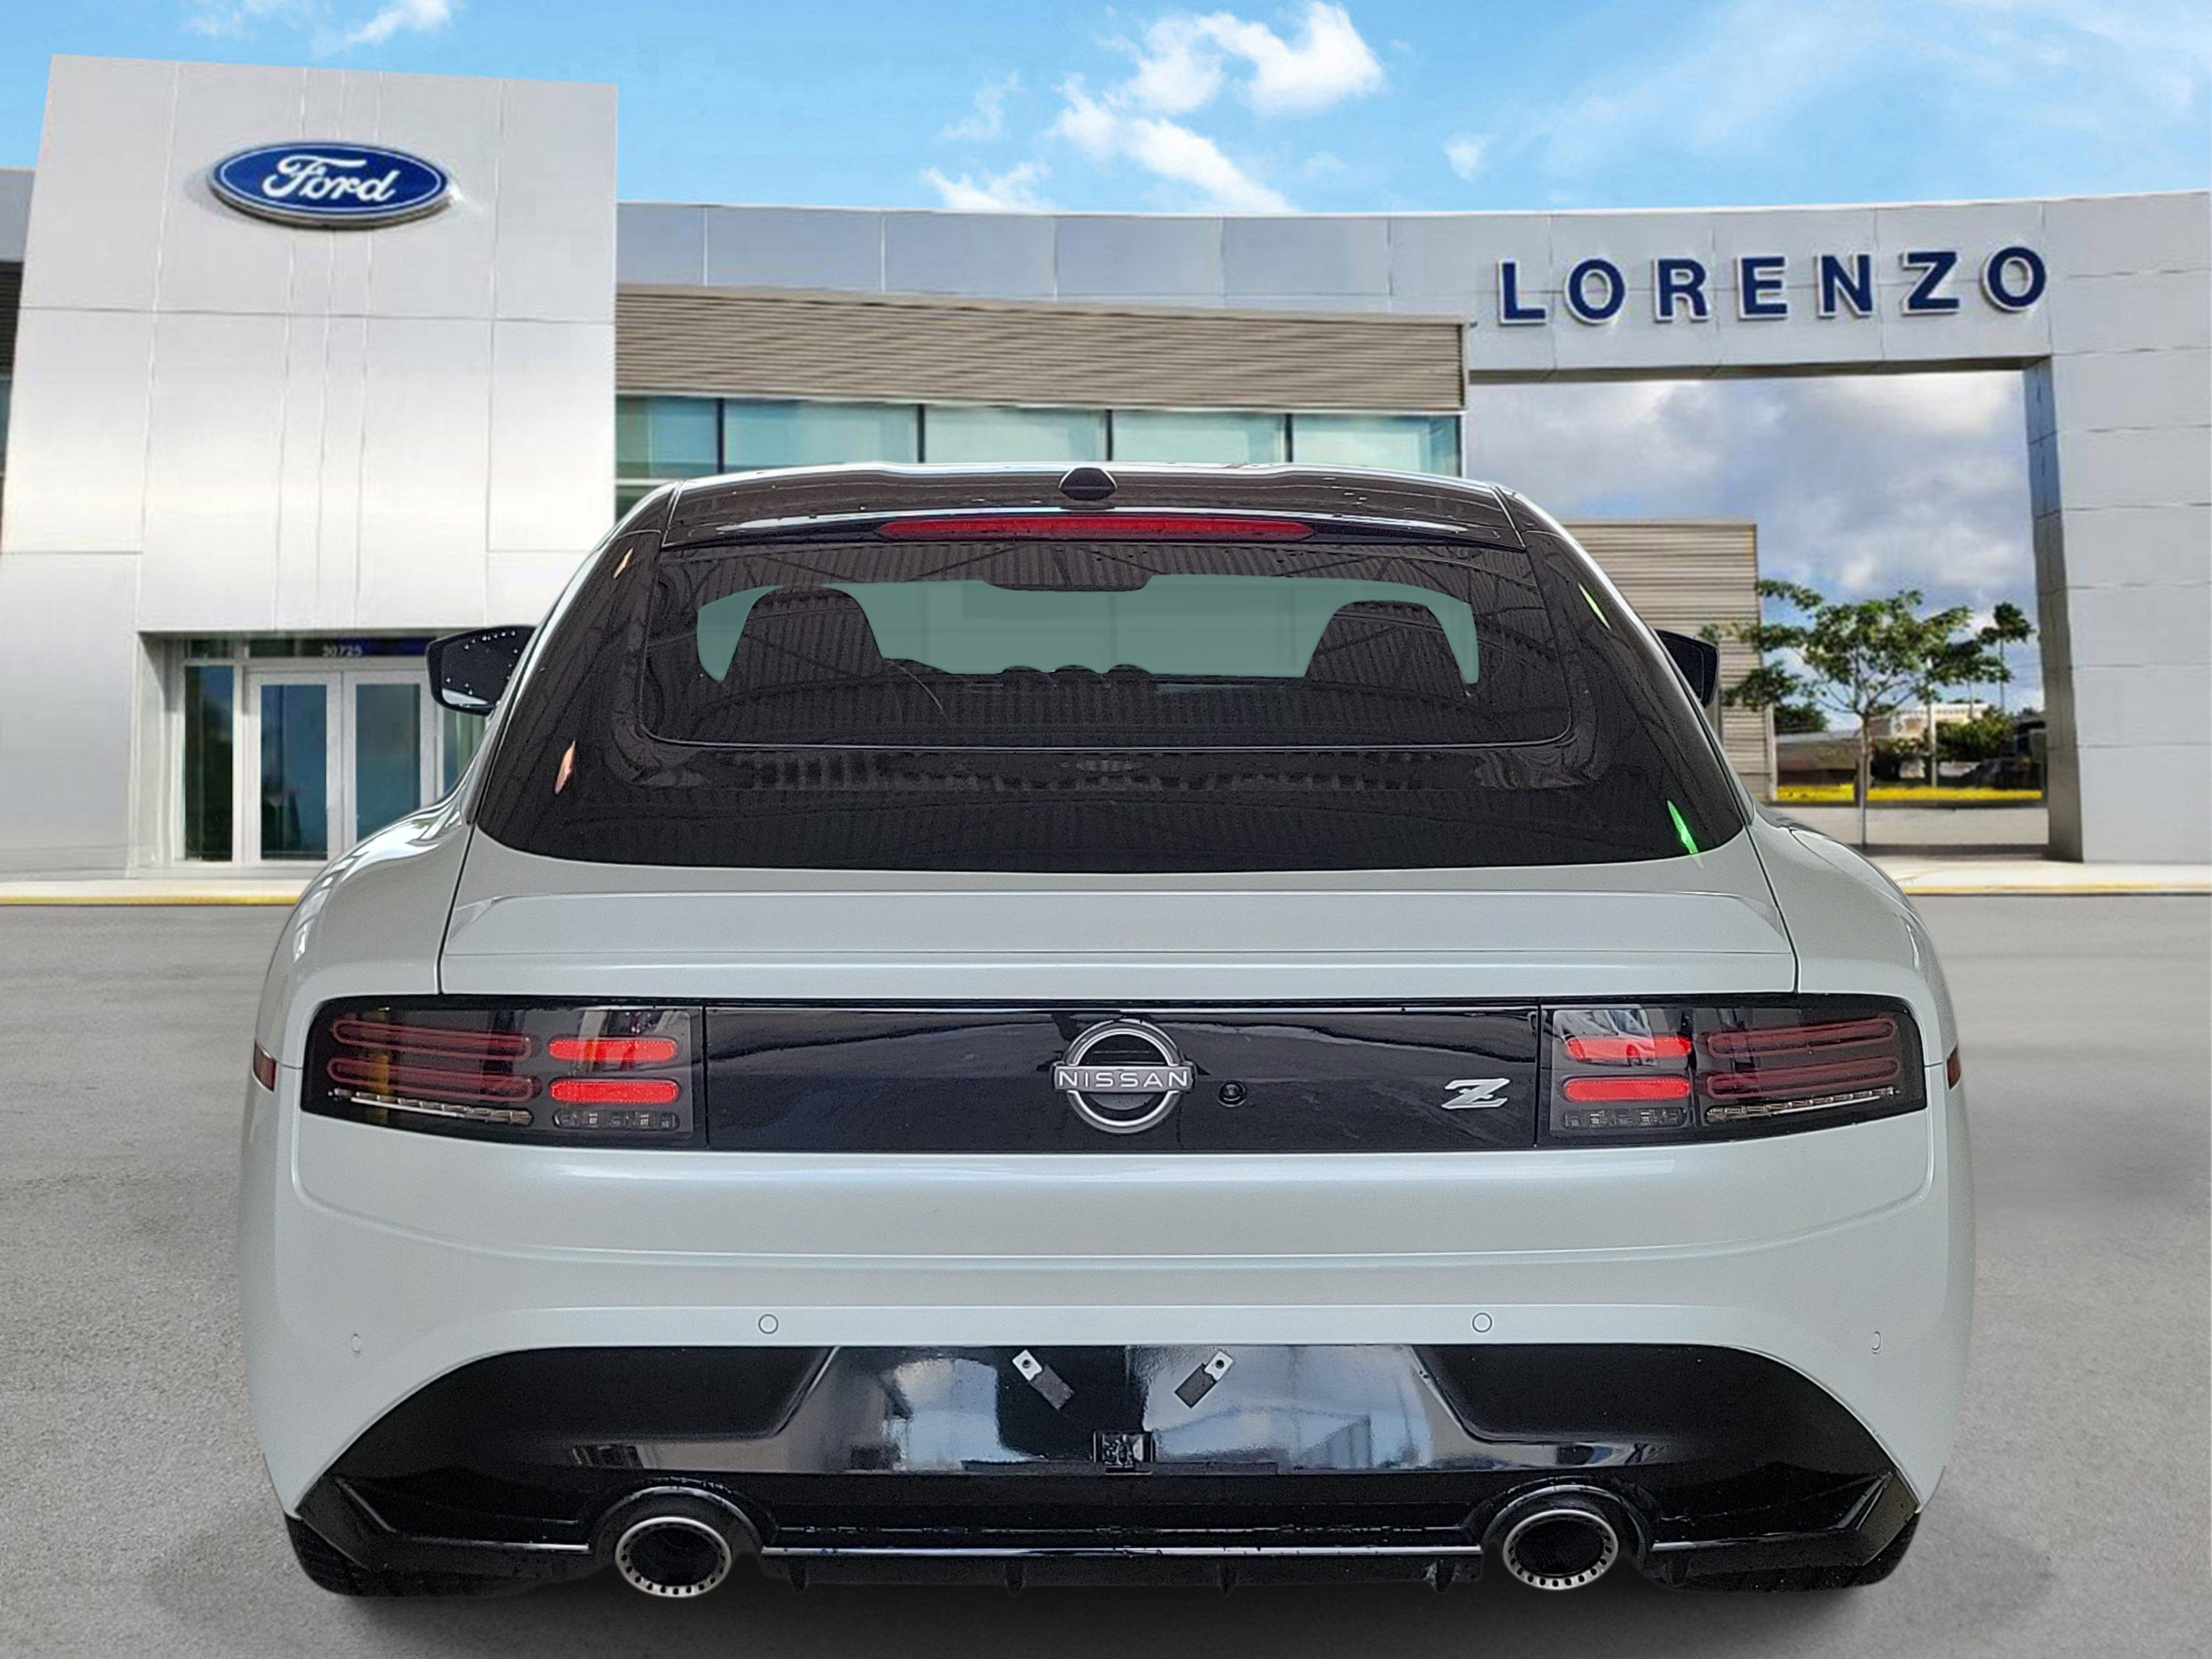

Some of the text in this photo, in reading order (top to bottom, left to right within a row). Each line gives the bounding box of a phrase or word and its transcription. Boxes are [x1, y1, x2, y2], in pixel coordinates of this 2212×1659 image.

[262, 154, 401, 202] Ford
[1497, 246, 2048, 326] LORENZO
[1058, 1071, 1188, 1088] NISSAN
[1440, 1078, 1510, 1110] Z
